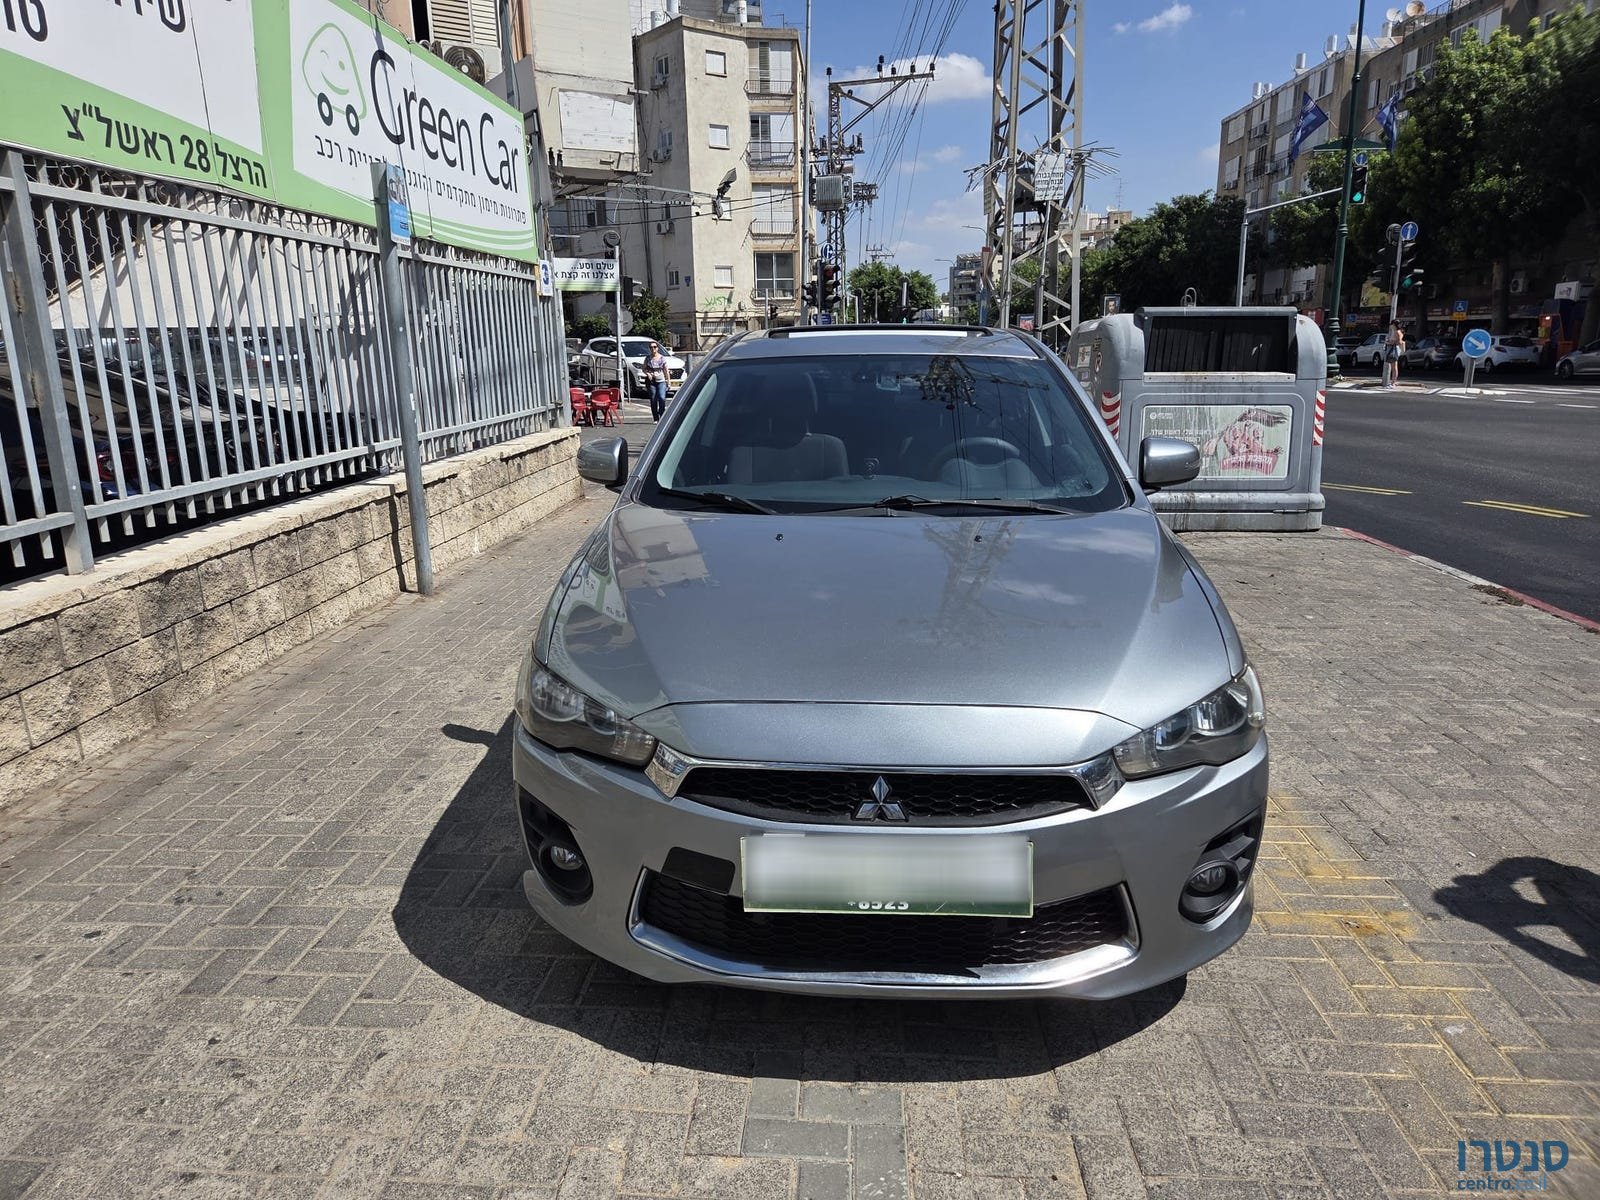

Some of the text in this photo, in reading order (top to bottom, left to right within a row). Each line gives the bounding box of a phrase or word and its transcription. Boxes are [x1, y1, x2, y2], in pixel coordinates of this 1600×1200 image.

[369, 49, 519, 194] Green Car
[180, 134, 212, 174] 28
[314, 134, 343, 163] רכב
[214, 142, 268, 189] הרצל
[435, 179, 477, 208] מתקדמים
[478, 194, 499, 215] מימון
[500, 202, 527, 225] פתרונות
[560, 271, 579, 281] קצת
[592, 271, 615, 279] אצלנו
[595, 261, 614, 271] שלם
